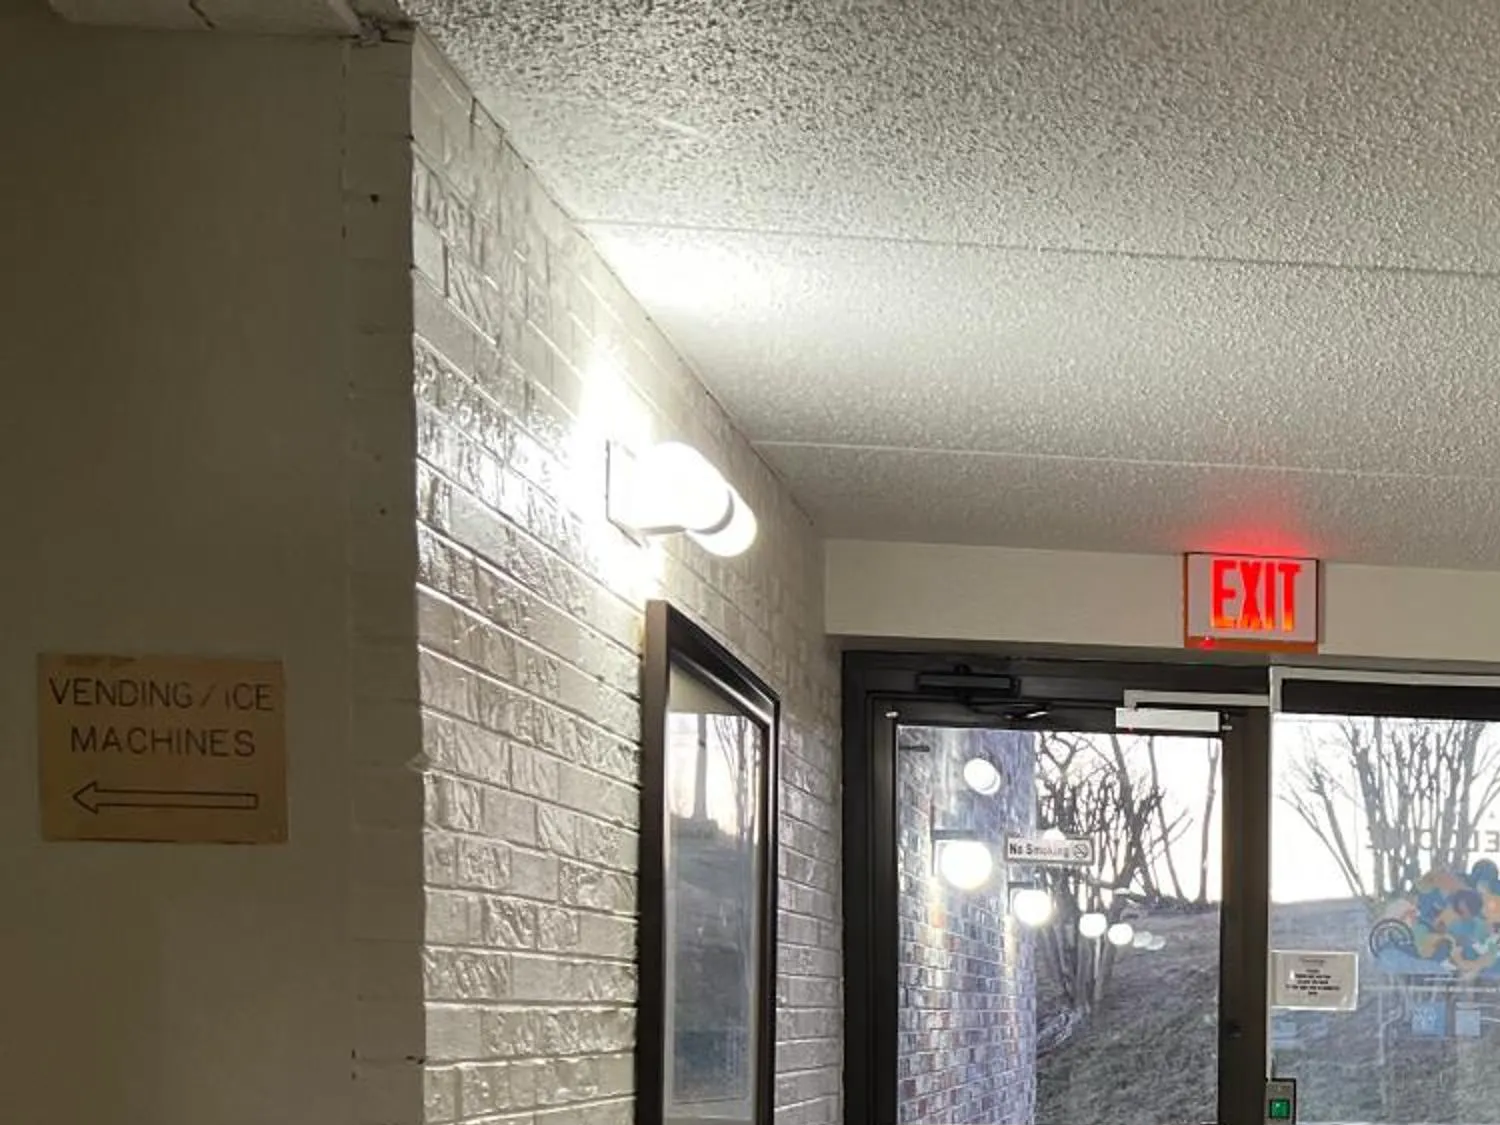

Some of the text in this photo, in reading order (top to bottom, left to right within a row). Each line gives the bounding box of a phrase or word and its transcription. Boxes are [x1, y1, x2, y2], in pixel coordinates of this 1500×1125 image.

[1213, 559, 1302, 632] EXIT
[48, 677, 193, 709] VENDING
[70, 726, 256, 758] MACHINES
[1009, 843, 1023, 855] No
